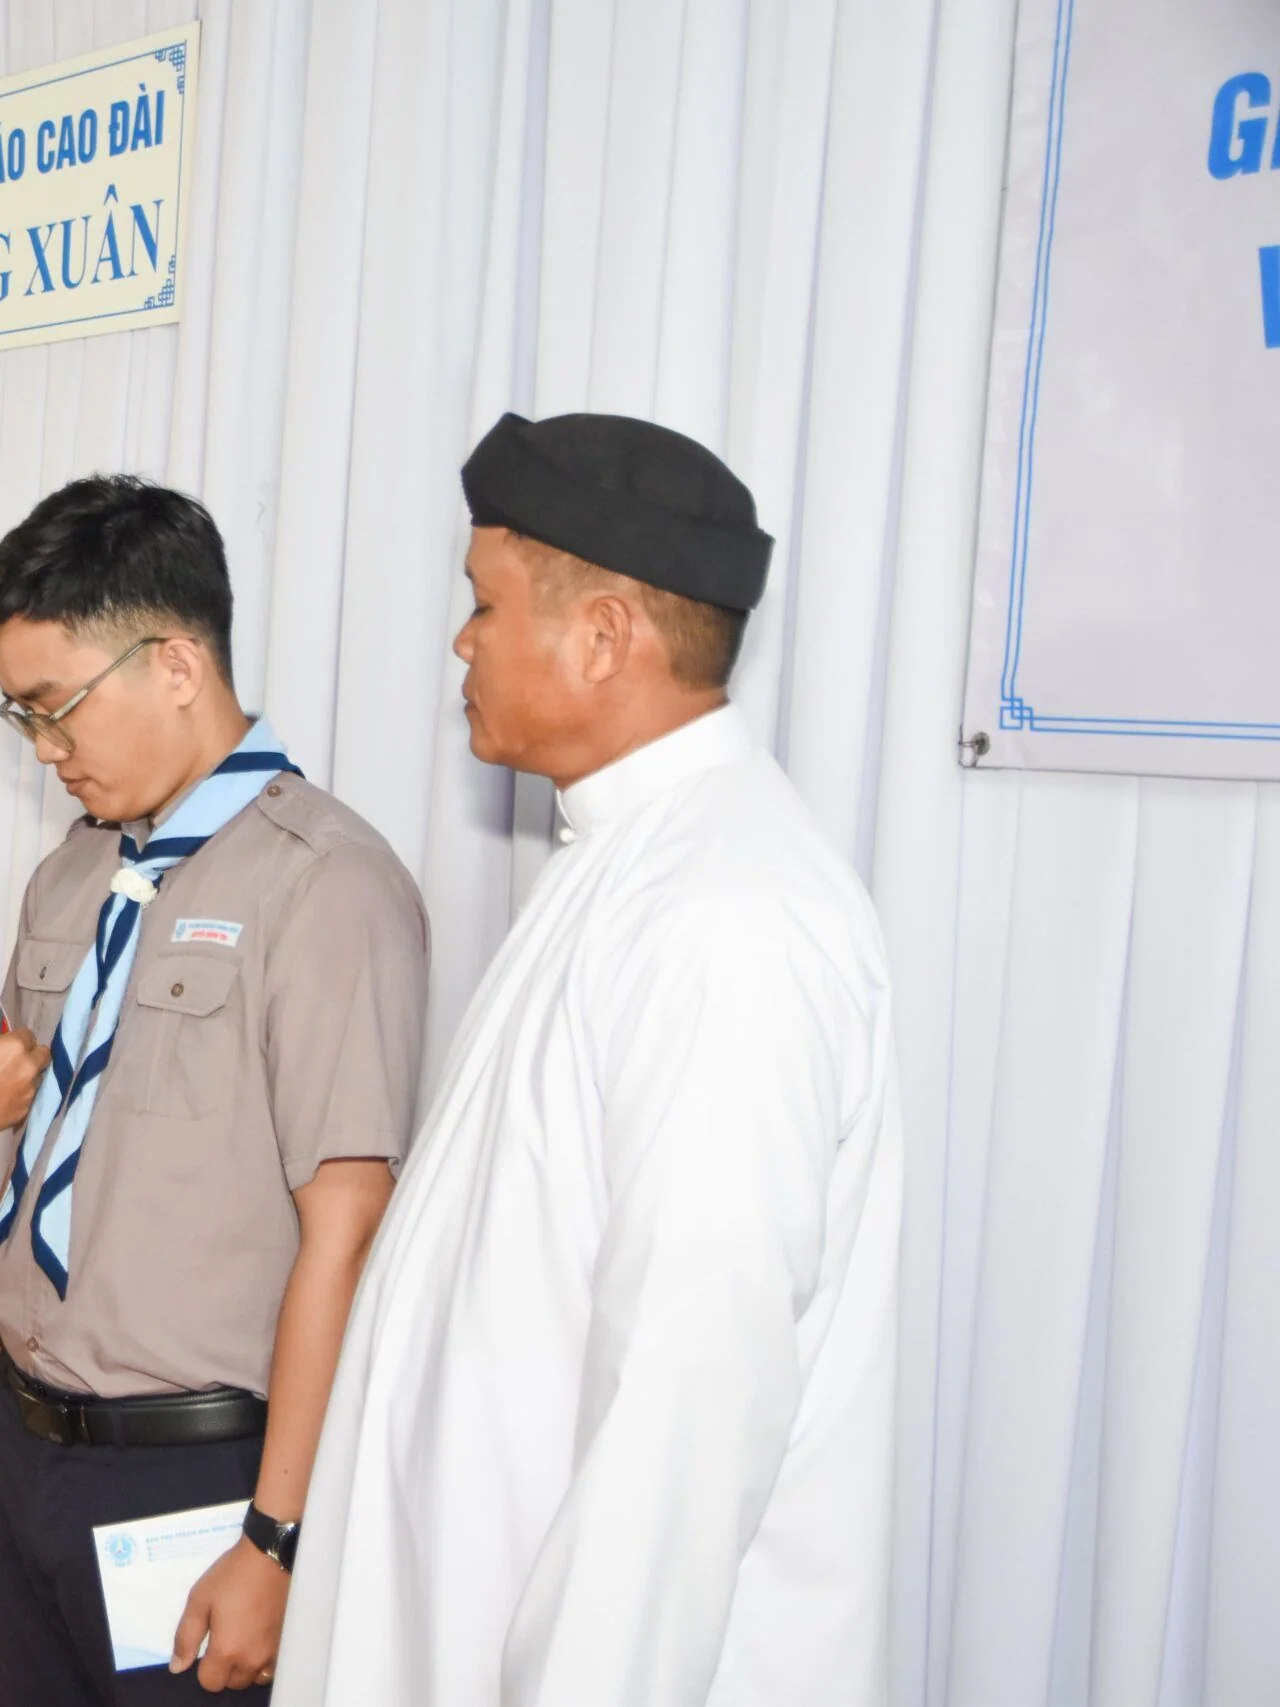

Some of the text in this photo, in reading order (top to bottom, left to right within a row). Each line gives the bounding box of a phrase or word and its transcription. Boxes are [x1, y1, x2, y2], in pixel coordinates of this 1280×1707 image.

[36, 108, 98, 174] CAO
[108, 83, 166, 157] ĐÀI
[1207, 71, 1280, 181] G
[23, 183, 165, 297] XUÂN
